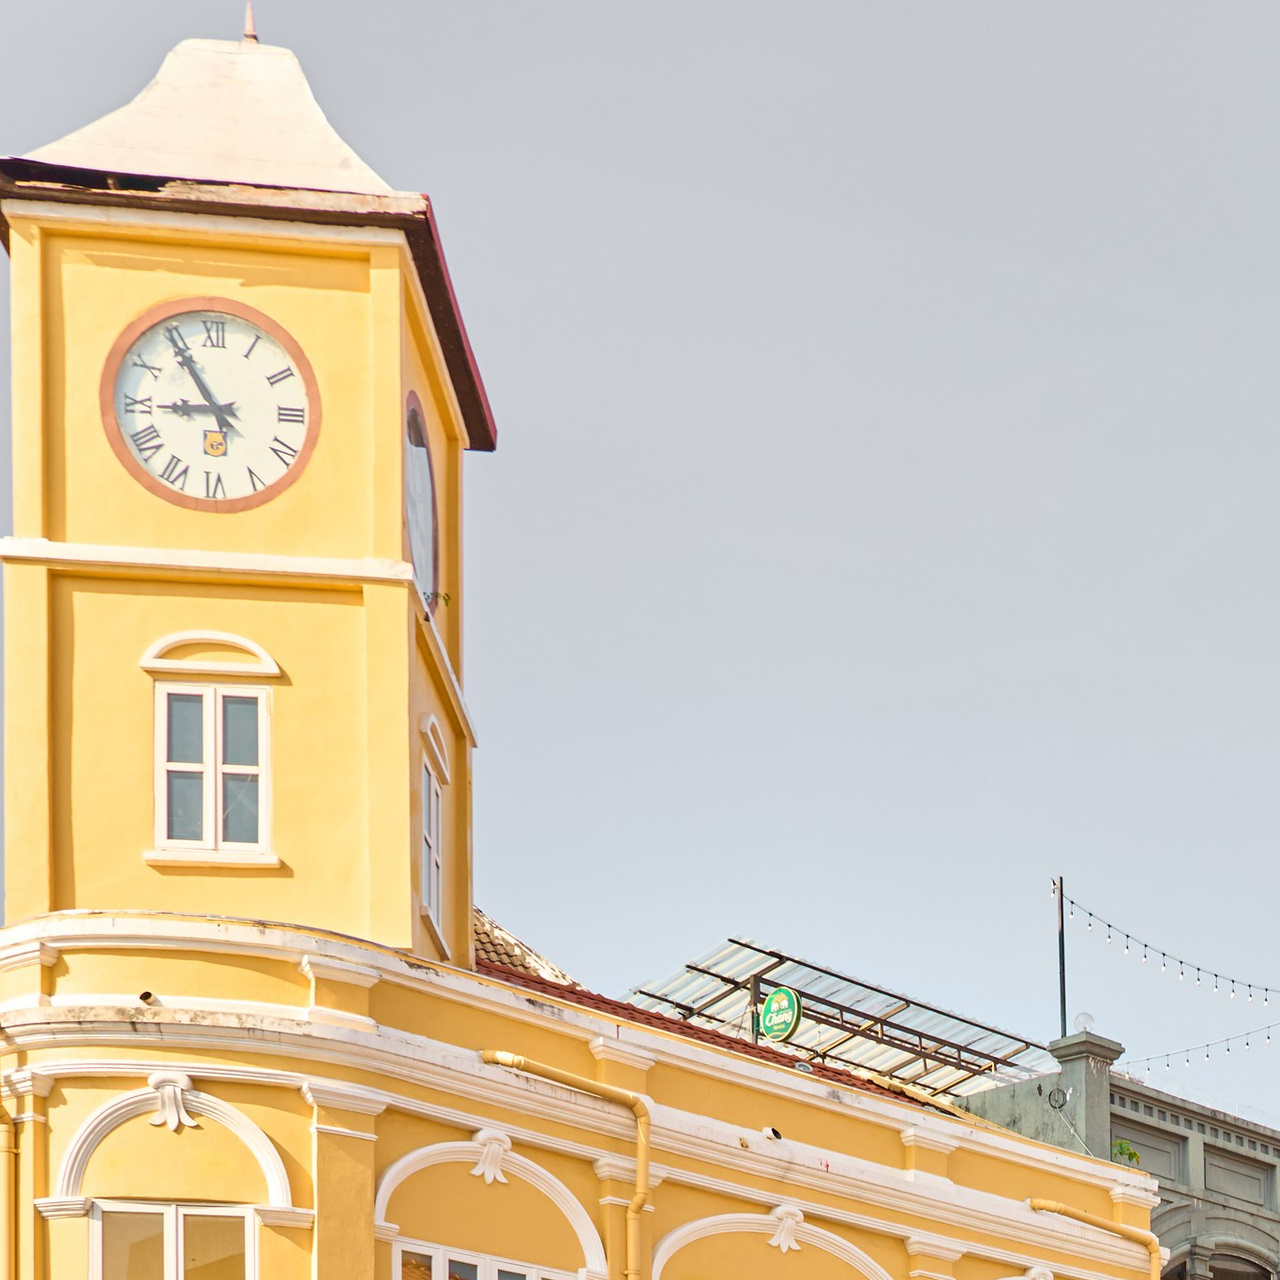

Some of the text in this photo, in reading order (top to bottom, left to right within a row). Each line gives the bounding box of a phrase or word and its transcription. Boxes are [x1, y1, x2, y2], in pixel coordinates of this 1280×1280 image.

[201, 320, 227, 349] XII
[132, 353, 162, 382] X
[266, 366, 295, 388] II
[124, 393, 152, 415] IX
[277, 405, 304, 424] III
[130, 424, 165, 464] VIII
[269, 436, 298, 469] IV
[158, 453, 190, 492] VII
[204, 471, 226, 499] VI
[246, 466, 267, 492] V
[765, 1010, 793, 1027] Chang
